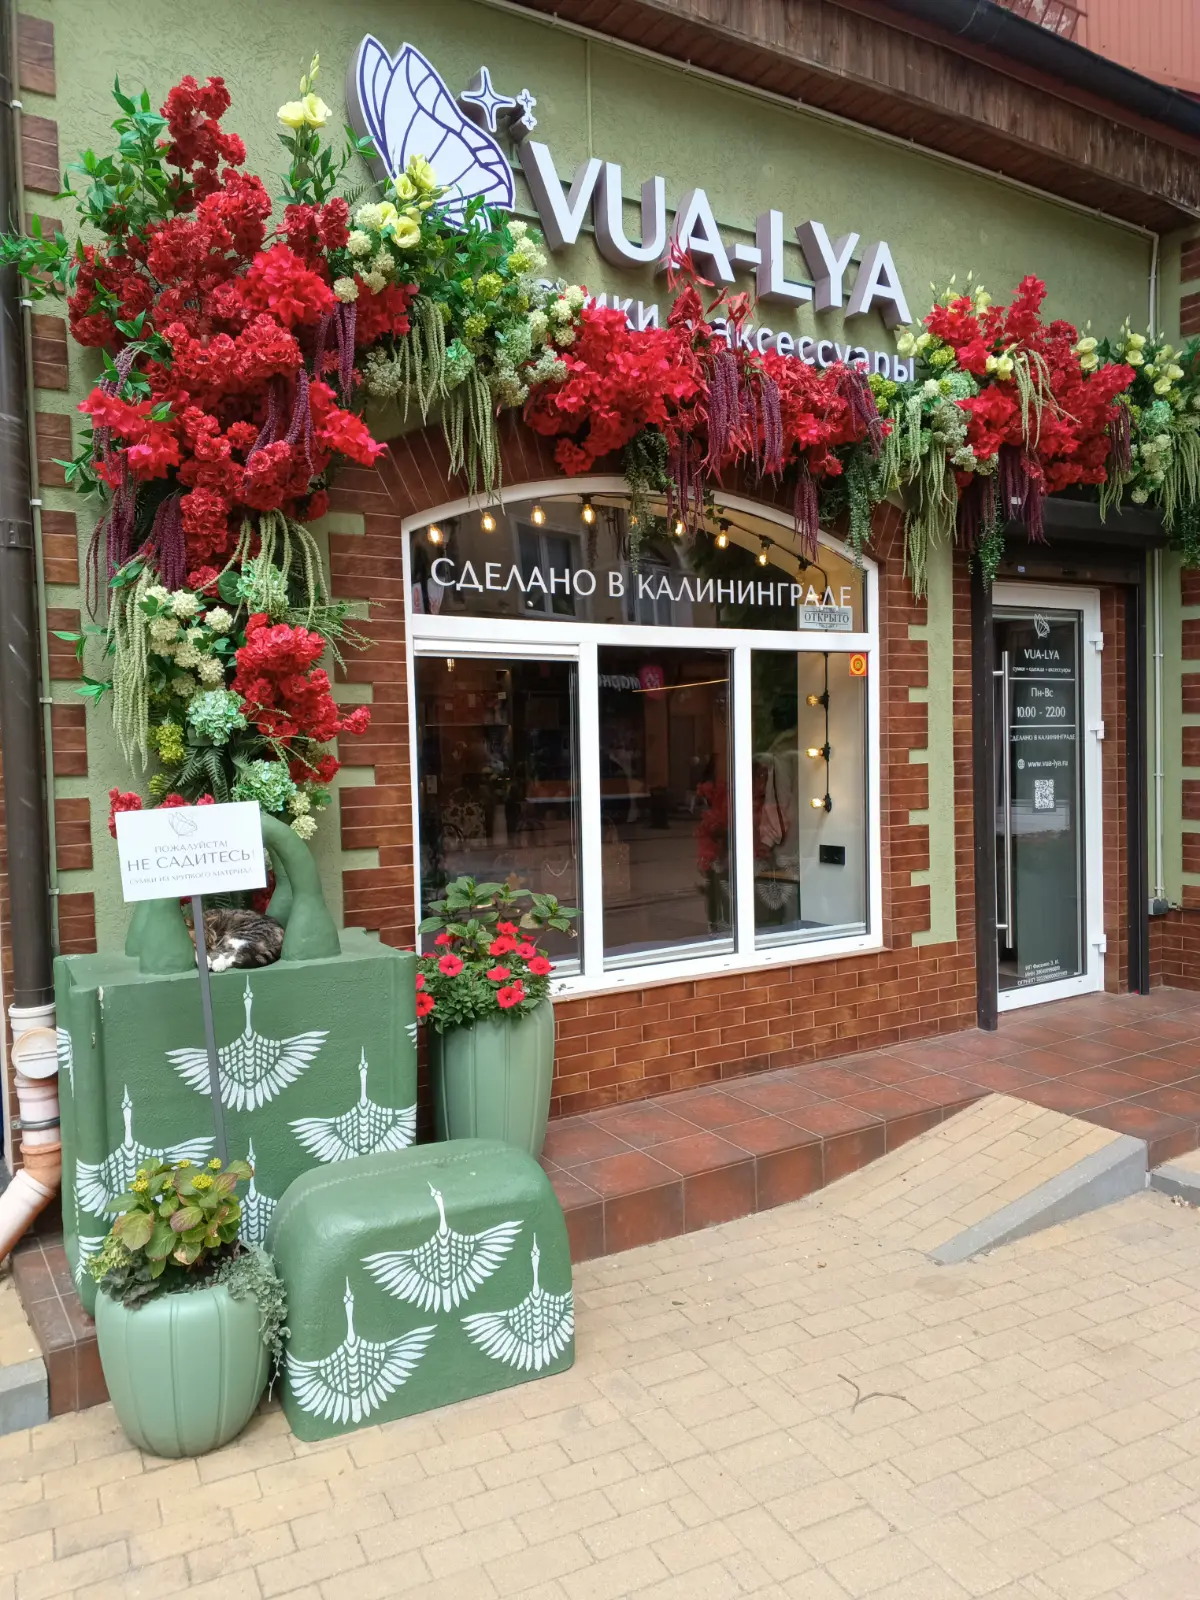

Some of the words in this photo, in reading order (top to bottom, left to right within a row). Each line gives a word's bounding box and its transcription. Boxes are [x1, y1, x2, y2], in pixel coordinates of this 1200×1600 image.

[521, 141, 912, 328] VUA-LYA
[711, 317, 915, 382] аксессуары
[430, 557, 596, 597] СДЕЛАНО
[608, 571, 625, 598] В
[638, 574, 852, 610] КАЛИНИНГРАДЕ
[804, 612, 850, 623] ОТКРЫТО
[1023, 648, 1060, 660] VUA-LYA
[1031, 687, 1054, 698] Пн-Вс
[1027, 759, 1069, 769] www.vua-lya.ru
[154, 840, 228, 854] ПОЖАЛУЙСТА!
[127, 858, 151, 872] НЕ
[156, 848, 256, 869] САДИТЕСЬ!
